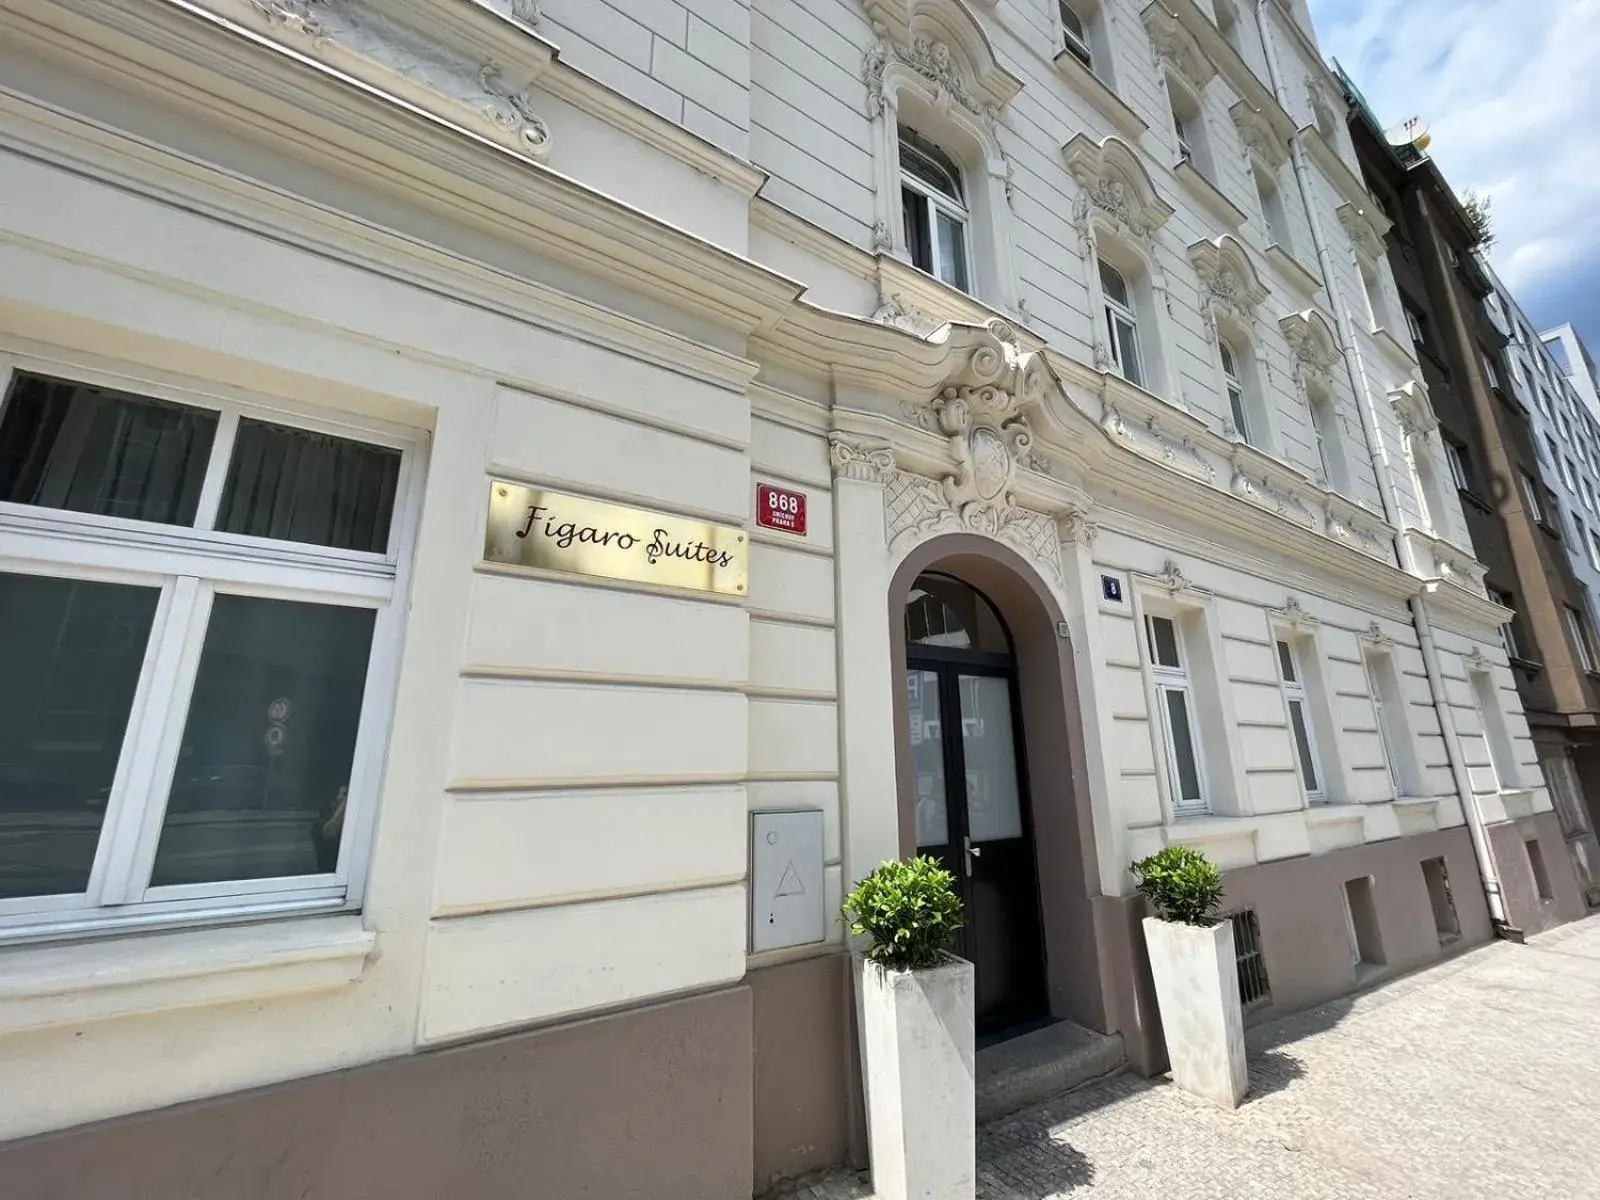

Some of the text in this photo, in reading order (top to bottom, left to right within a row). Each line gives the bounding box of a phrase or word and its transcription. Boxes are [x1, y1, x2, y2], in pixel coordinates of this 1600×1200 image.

[769, 492, 798, 513] 868
[772, 518, 790, 526] PRAHA
[516, 506, 734, 567] Figaro Suites
